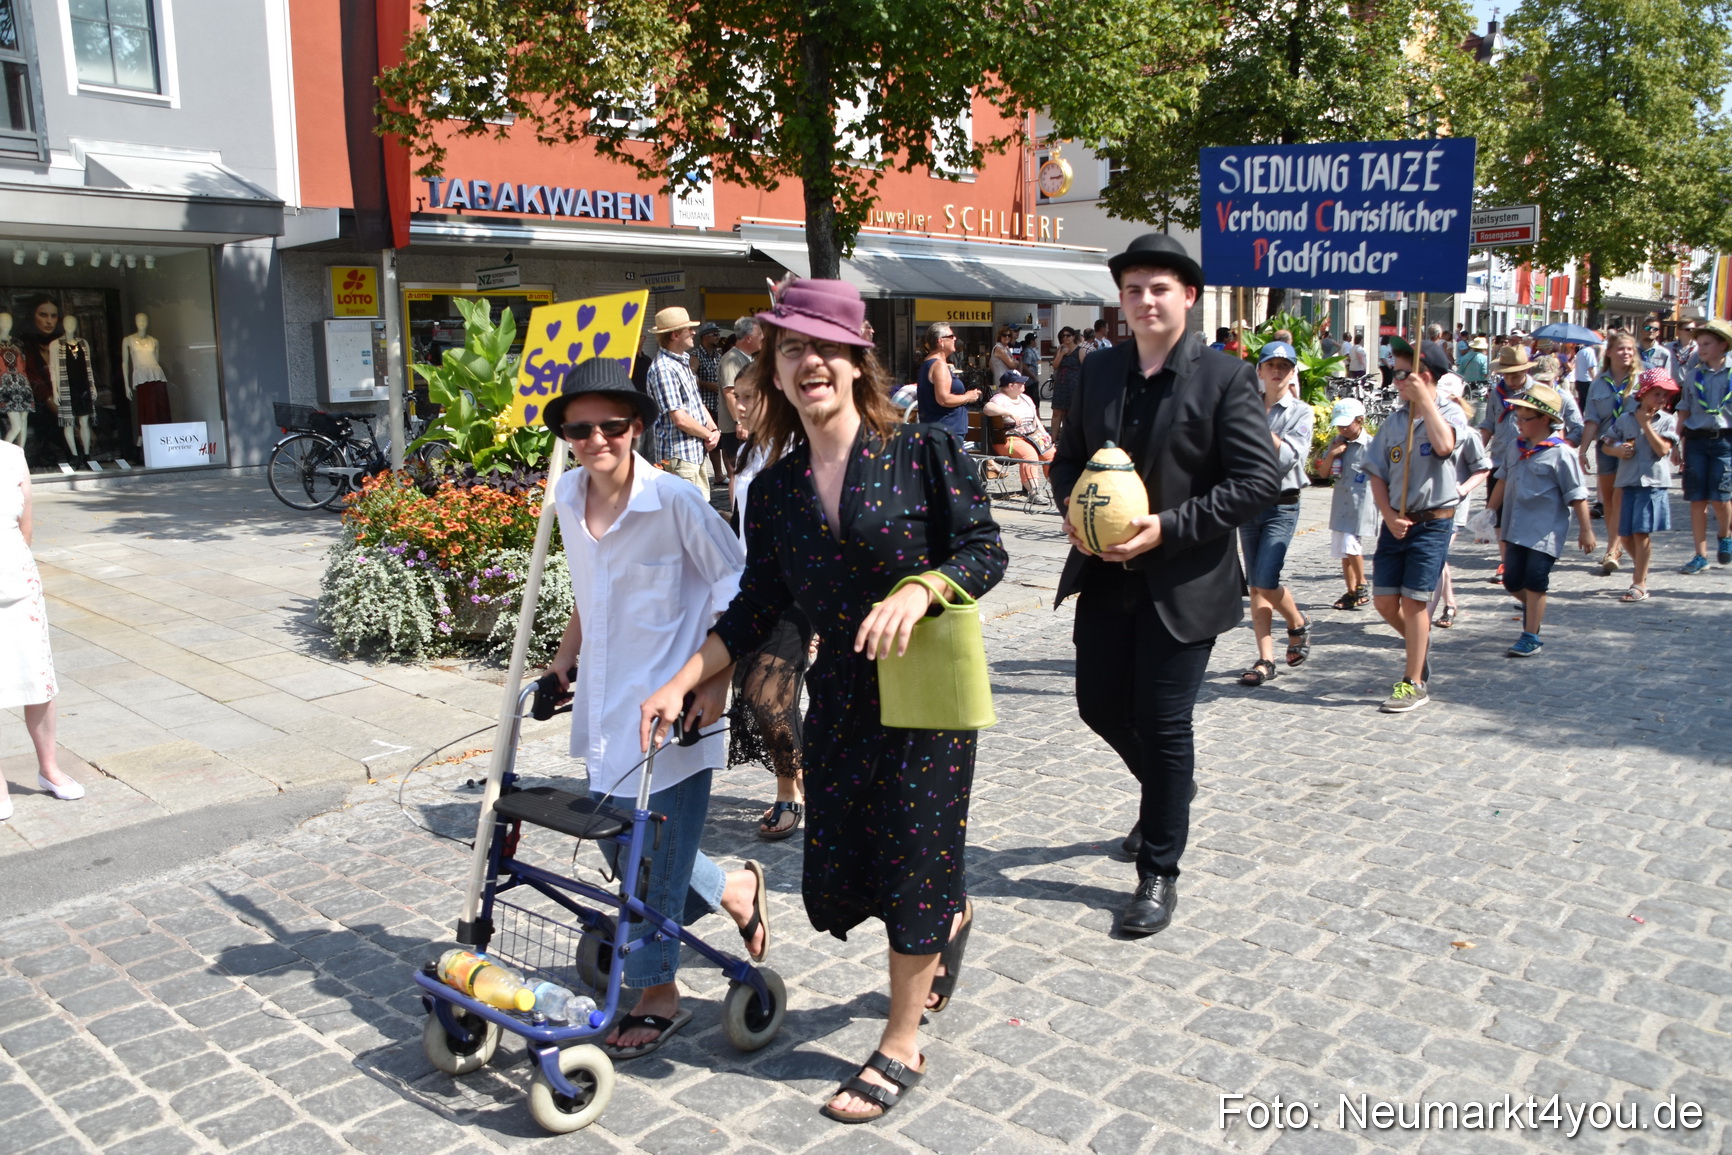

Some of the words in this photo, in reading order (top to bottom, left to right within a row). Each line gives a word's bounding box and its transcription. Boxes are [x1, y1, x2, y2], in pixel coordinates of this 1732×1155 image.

[1218, 154, 1350, 194] SIEDLUNG
[1358, 142, 1445, 192] TAIZÉ
[422, 176, 654, 221] TABAKWAREN
[679, 209, 710, 220] THUMANN
[1216, 201, 1308, 233] Verband
[1315, 200, 1457, 233] Christlicher
[869, 209, 932, 226] juwelier
[943, 204, 1064, 240] SCHLIERF
[1480, 230, 1520, 241] Rosengasse
[1253, 238, 1398, 278] Pfadfinder
[478, 274, 492, 286] NZ
[626, 271, 635, 280] 41
[644, 274, 680, 285] NEUMARKTER
[337, 294, 372, 305] LOTTO
[947, 310, 992, 321] SCHLIERF
[160, 434, 199, 445] SEASON
